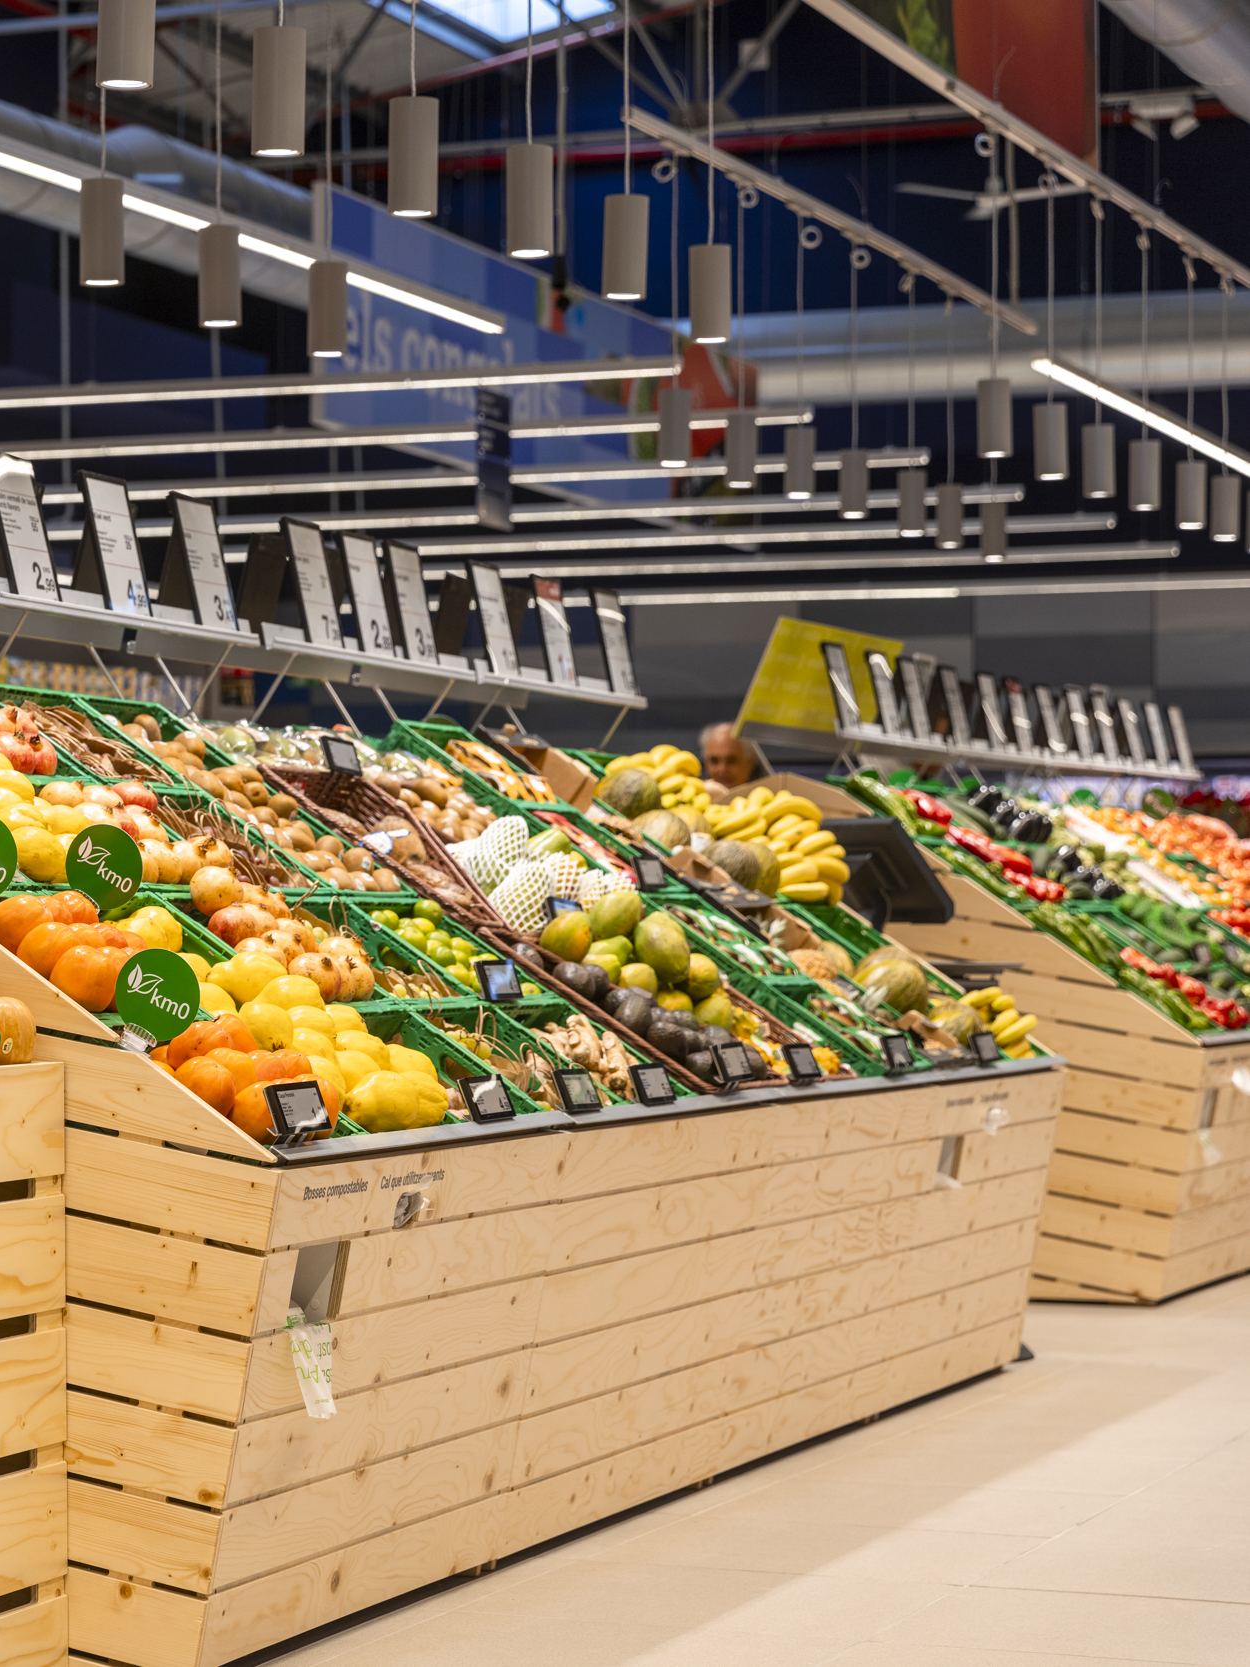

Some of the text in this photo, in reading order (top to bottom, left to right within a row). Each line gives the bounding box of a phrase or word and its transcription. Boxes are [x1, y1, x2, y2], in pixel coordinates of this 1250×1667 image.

[97, 860, 133, 894] km0
[150, 987, 190, 1020] km0
[303, 1177, 368, 1201] Bosses compostables
[381, 1174, 392, 1189] Cal
[391, 1175, 402, 1191] que
[427, 1168, 445, 1181] ants
